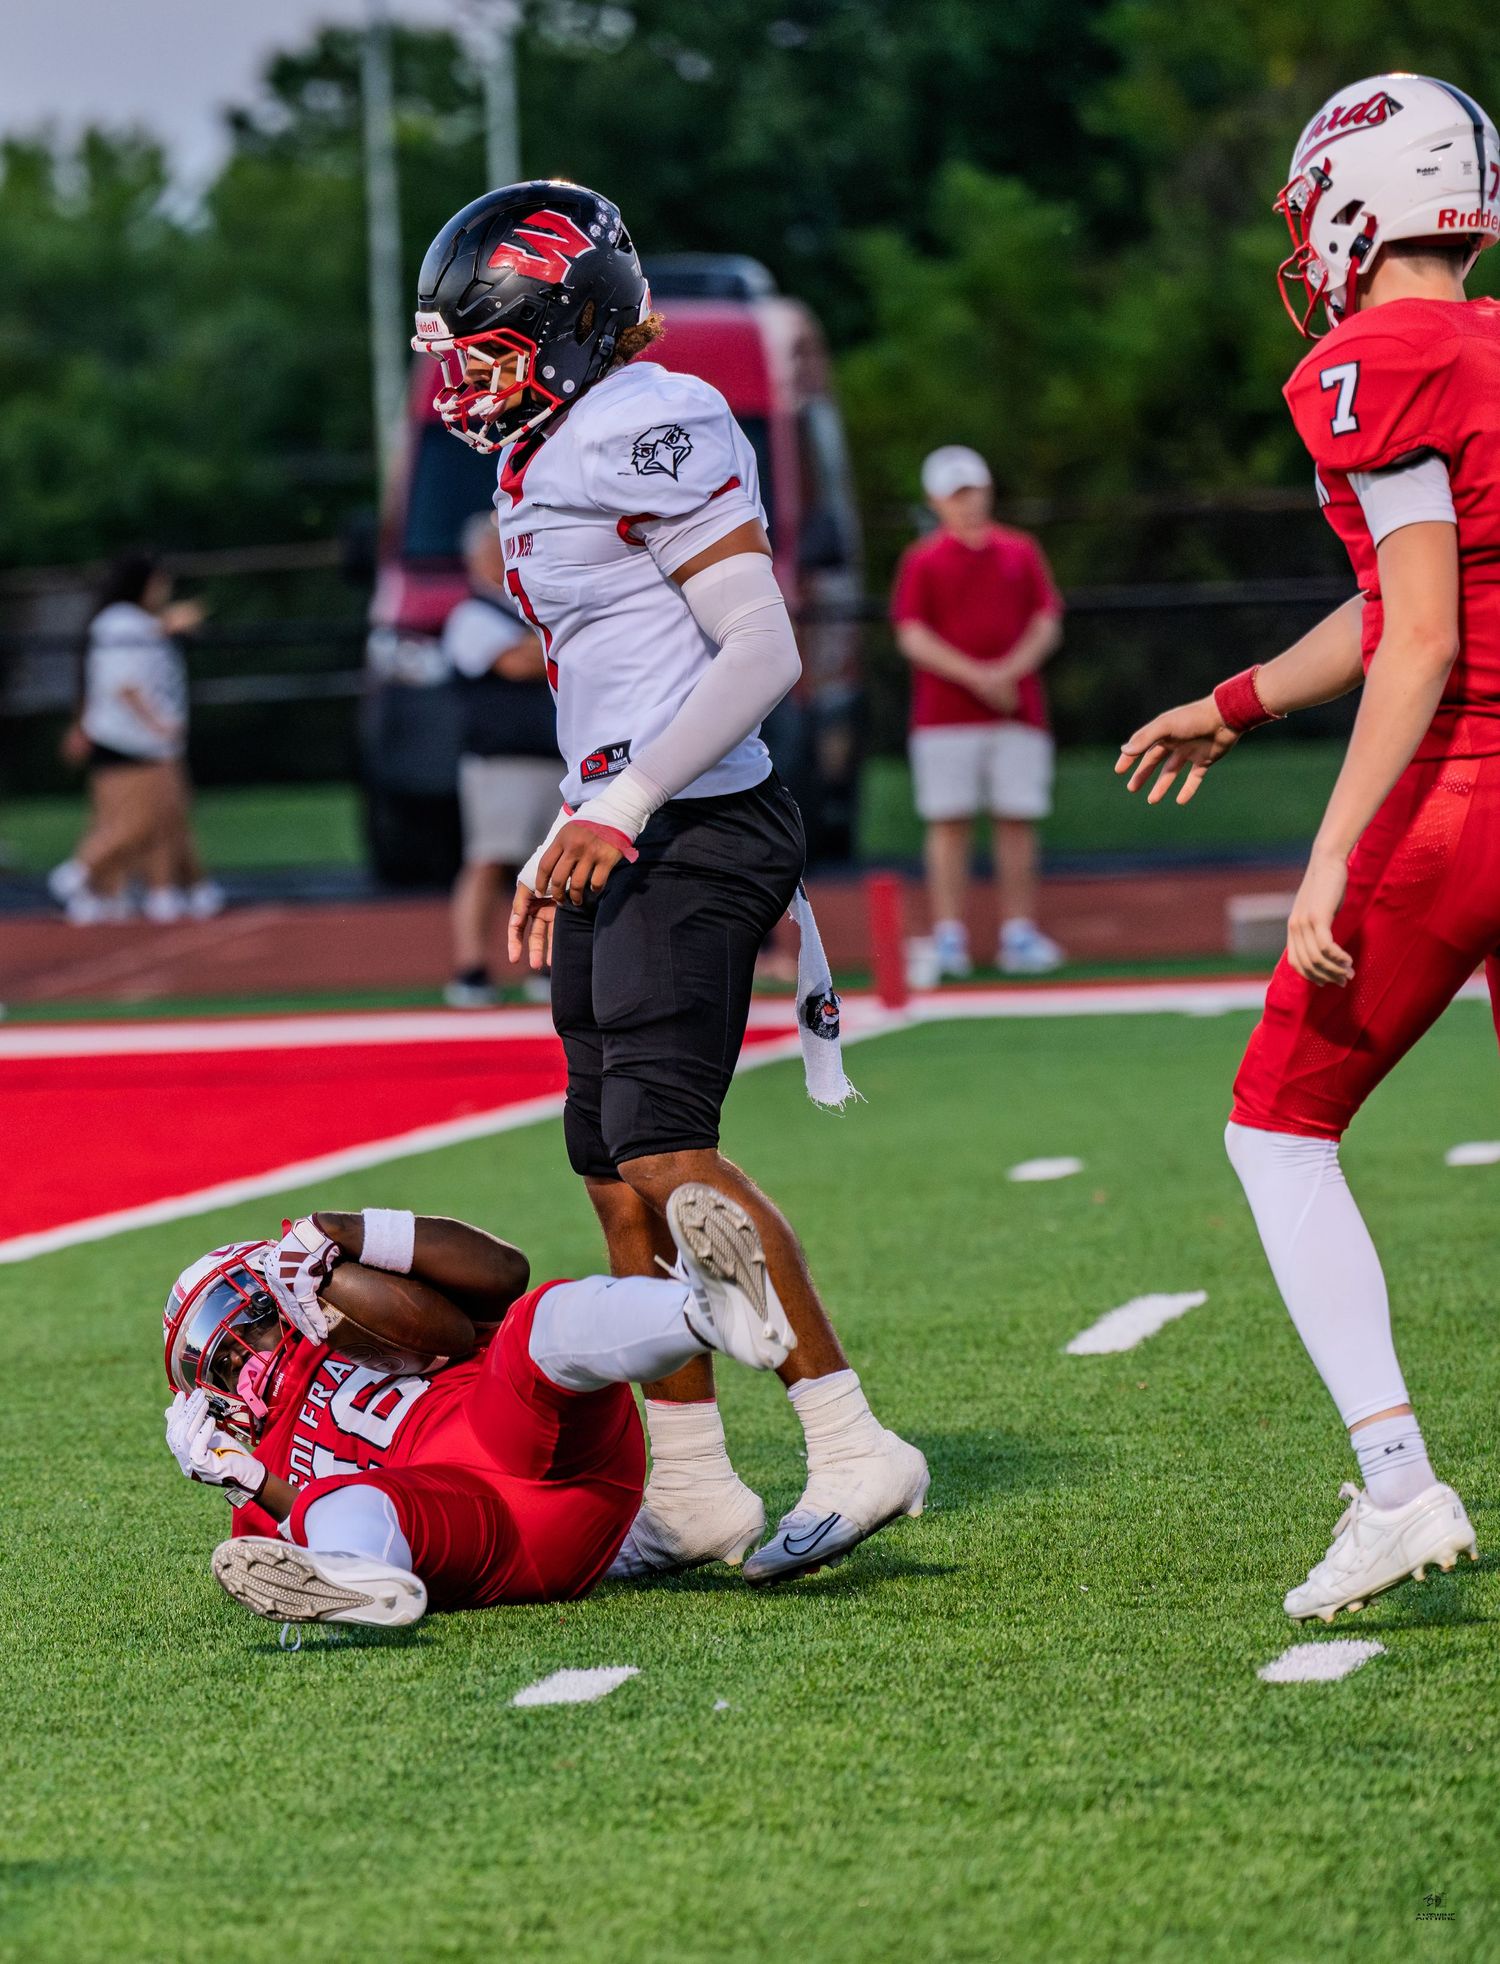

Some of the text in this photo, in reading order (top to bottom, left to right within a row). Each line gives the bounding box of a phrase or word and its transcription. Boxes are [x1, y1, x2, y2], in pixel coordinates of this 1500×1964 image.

[1437, 207, 1500, 229] Ridde
[1320, 360, 1360, 438] 7
[612, 747, 624, 760] M
